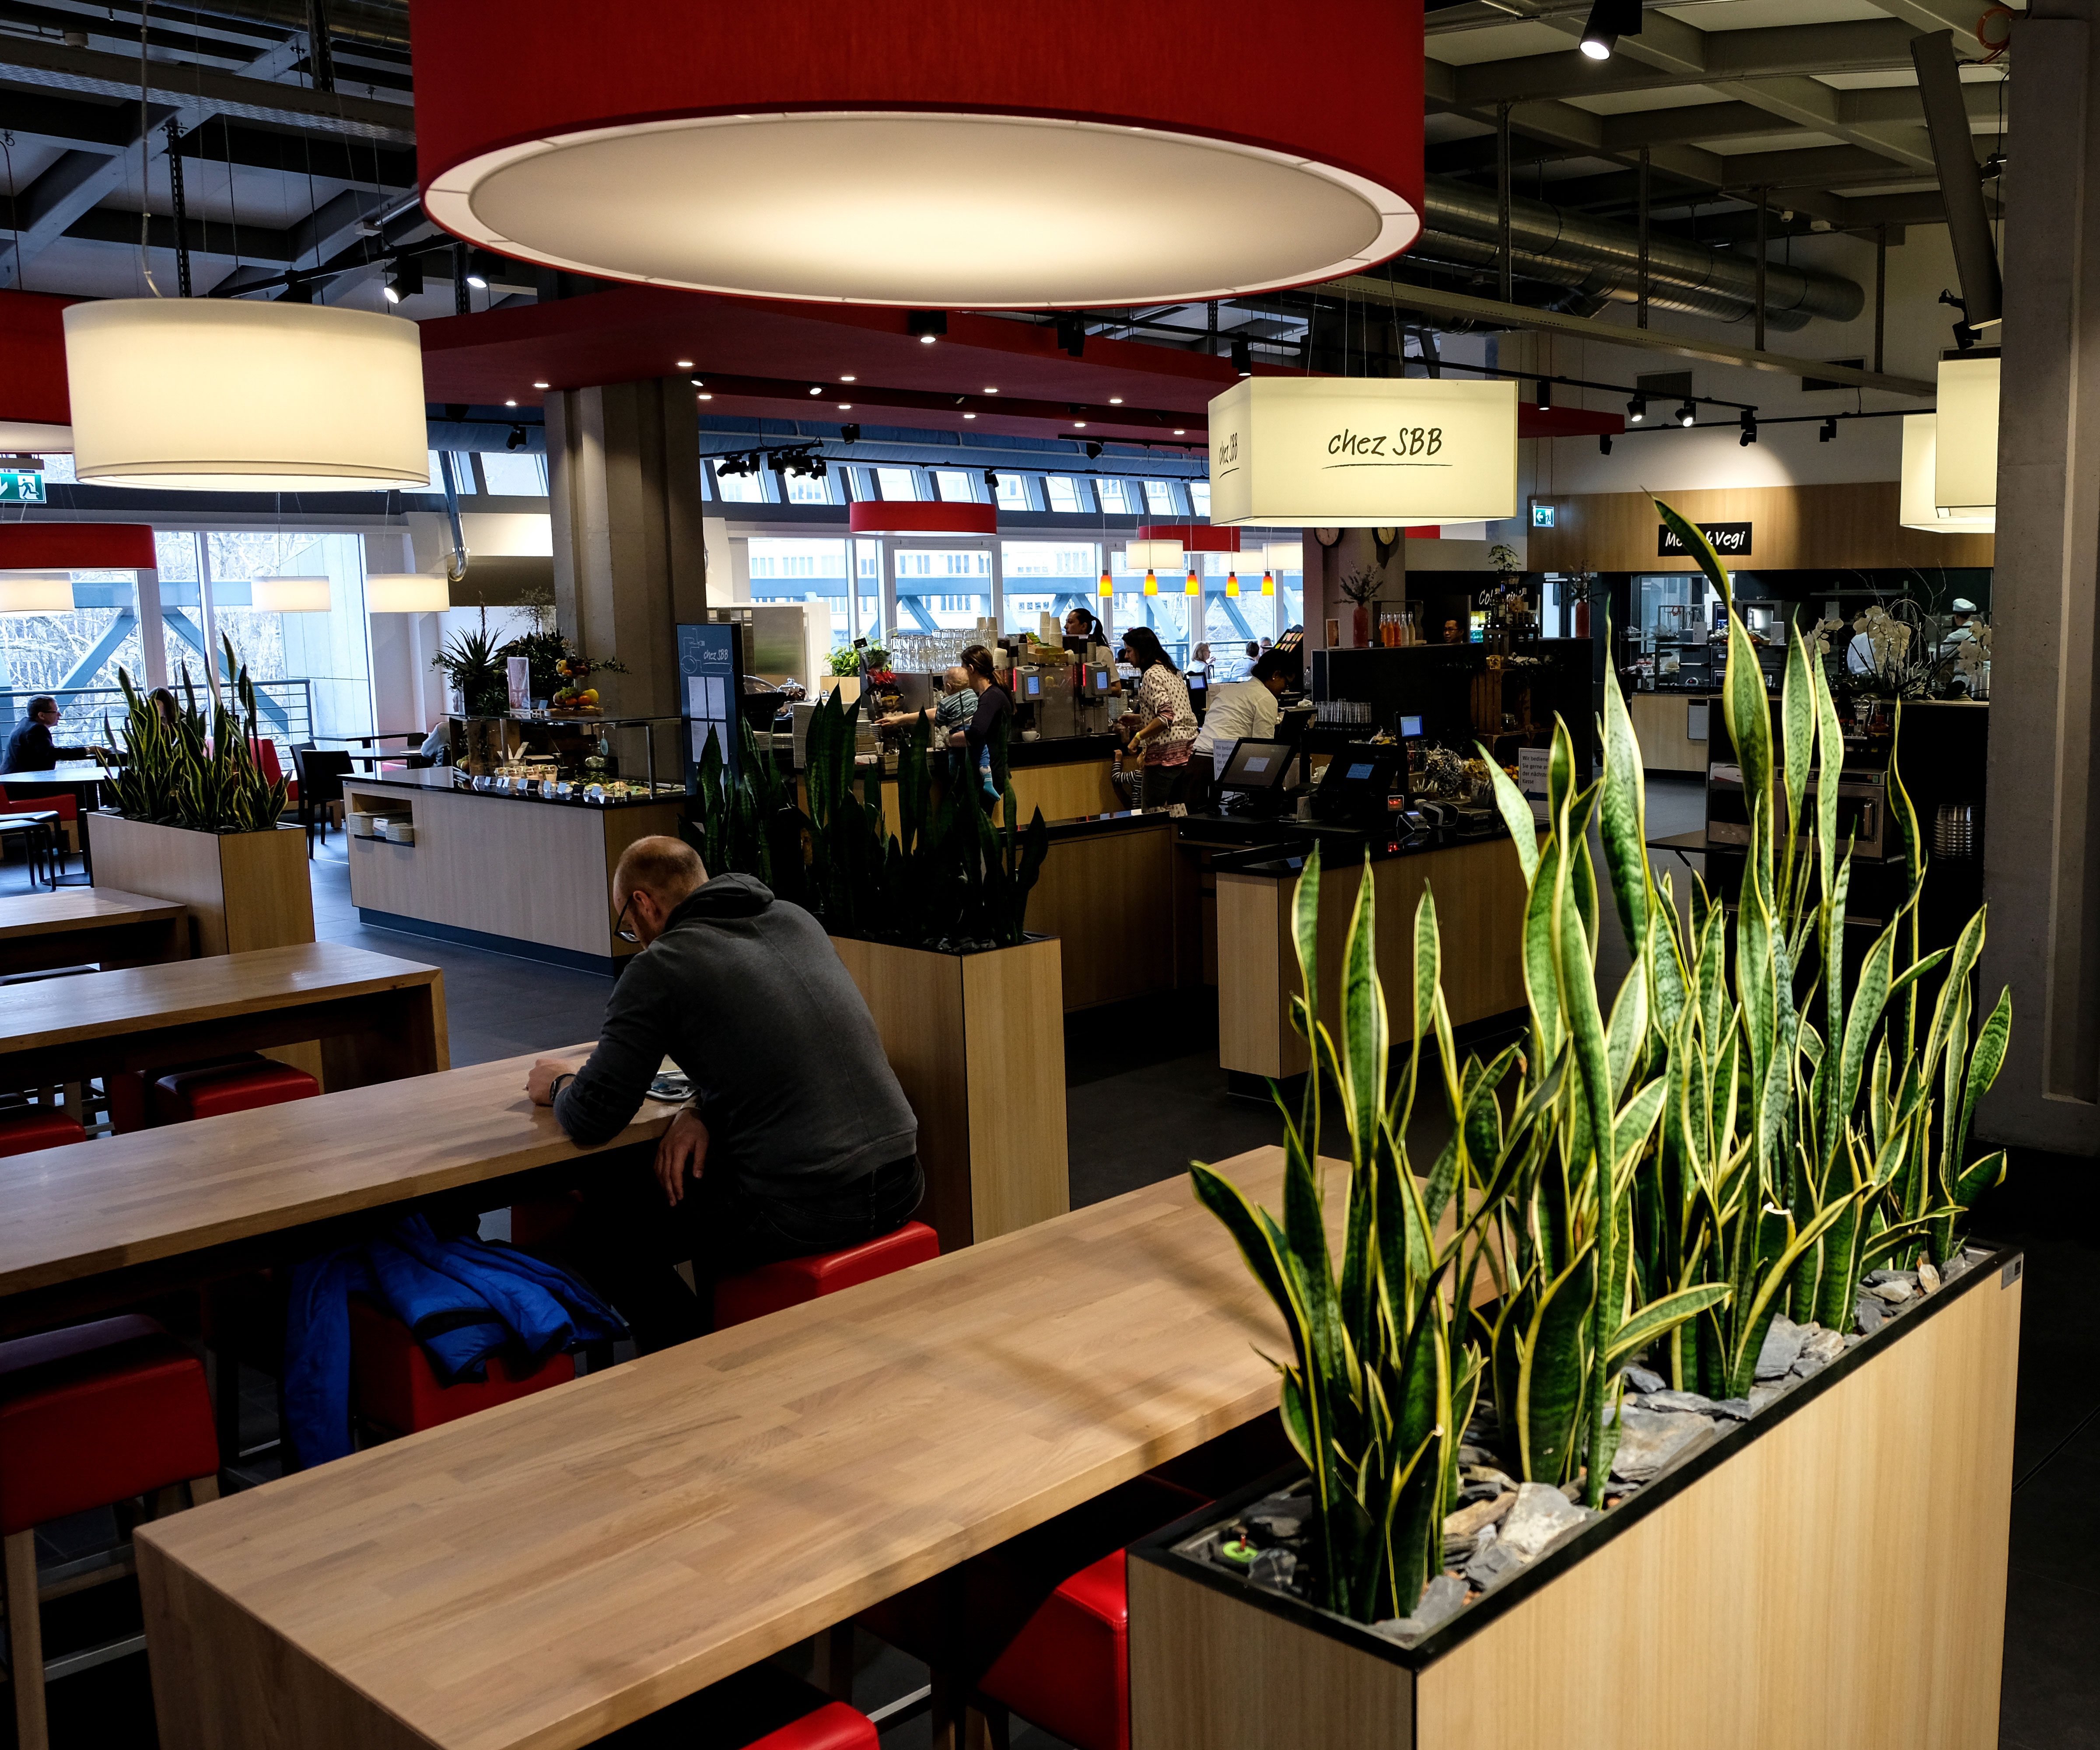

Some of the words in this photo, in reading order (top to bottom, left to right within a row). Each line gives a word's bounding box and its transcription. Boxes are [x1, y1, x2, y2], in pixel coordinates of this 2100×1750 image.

[1328, 429, 1387, 456] chez
[1393, 427, 1442, 456] SBB
[1219, 441, 1228, 465] chez
[1715, 531, 1746, 549] Vegi
[704, 649, 717, 661] chez
[717, 649, 728, 661] SBB
